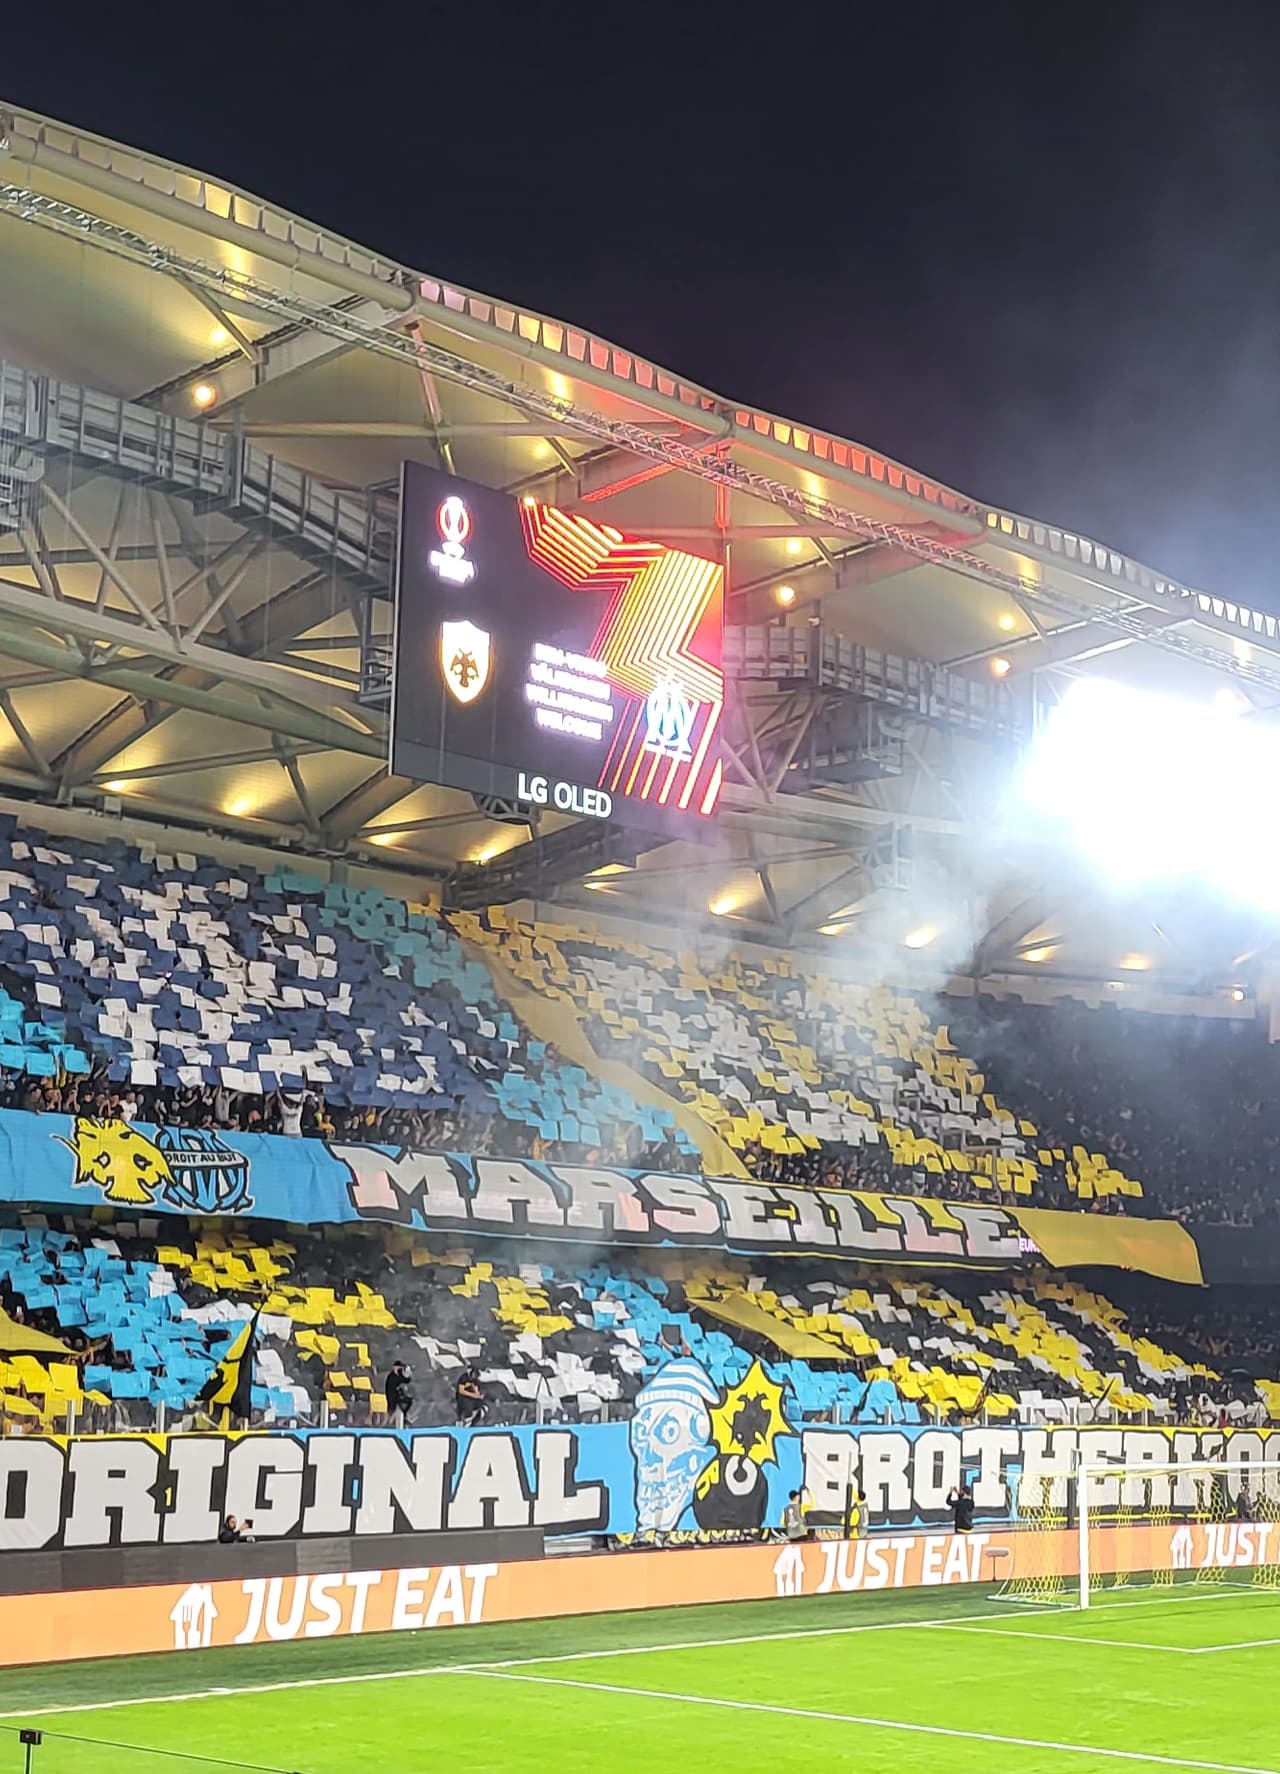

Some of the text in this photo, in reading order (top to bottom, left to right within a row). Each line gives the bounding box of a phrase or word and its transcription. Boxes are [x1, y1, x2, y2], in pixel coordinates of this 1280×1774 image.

[518, 772, 612, 818] LG OLED
[329, 1145, 1021, 1257] MARSEILLE
[817, 1534, 990, 1594] JUST EAT
[1201, 1523, 1271, 1567] JUST
[235, 1563, 498, 1644] JUST EAT
